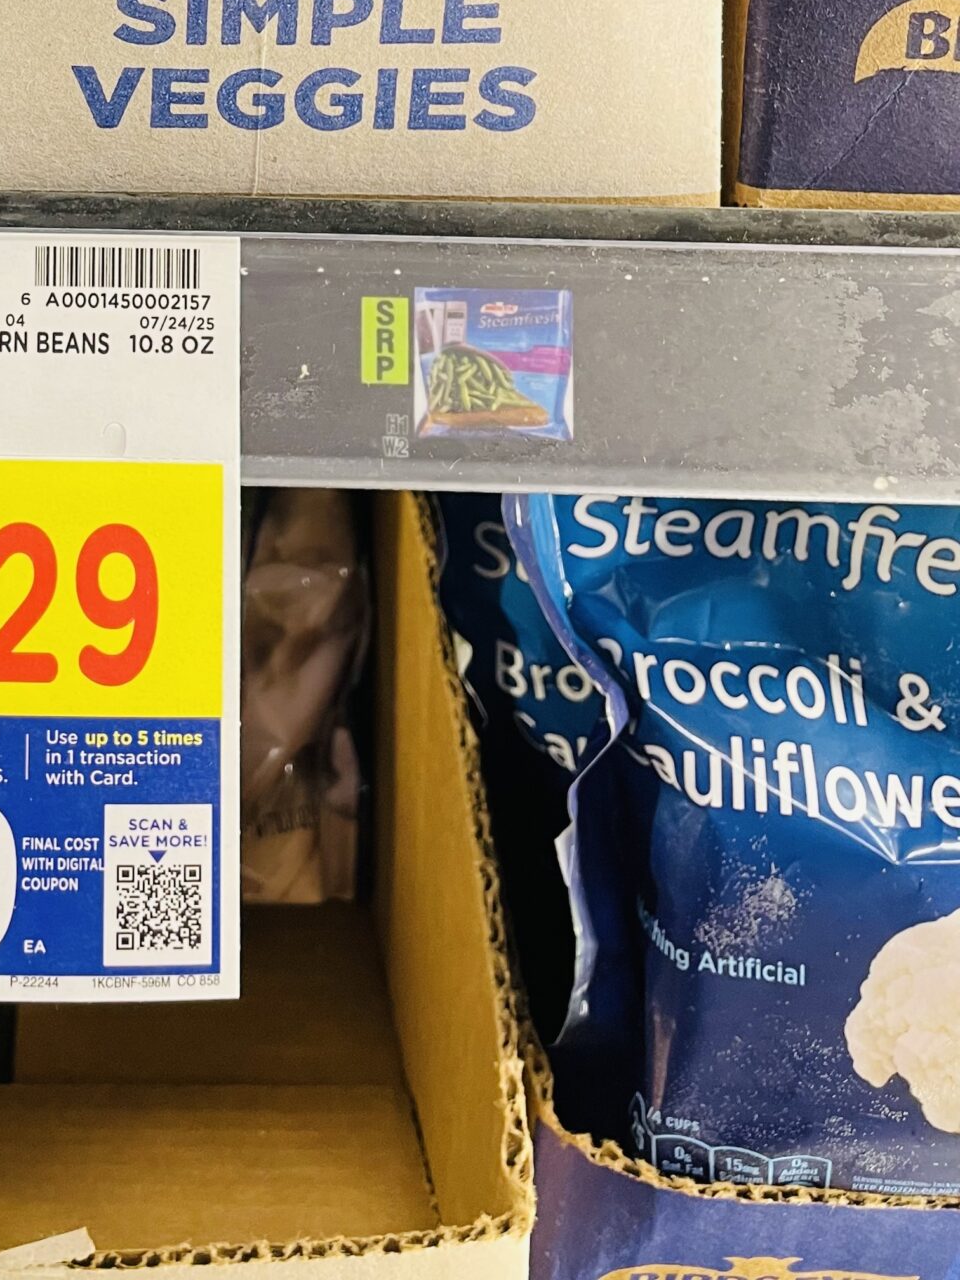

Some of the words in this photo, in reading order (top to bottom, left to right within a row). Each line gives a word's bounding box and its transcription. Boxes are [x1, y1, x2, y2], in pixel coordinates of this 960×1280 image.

[71, 64, 538, 134] VEGGIES
[20, 292, 31, 306] 6
[45, 292, 211, 310] A0001450002157
[5, 313, 25, 326] 04
[139, 316, 215, 331] 07/24/25
[36, 331, 110, 355] BEANS
[129, 334, 174, 354] 10.8
[182, 335, 215, 355] OZ
[895, 672, 946, 732] &
[46, 729, 78, 745] Use
[84, 732, 109, 747] up
[112, 731, 132, 746] to
[136, 731, 149, 746] 5
[153, 730, 203, 746] times
[45, 749, 62, 765] in
[66, 749, 74, 765] 1
[80, 750, 181, 765] transaction
[45, 769, 85, 785] with
[89, 770, 138, 786] Card.
[128, 818, 173, 831] SCAN
[178, 818, 188, 831] &
[21, 837, 61, 851] FINAL
[64, 837, 100, 851] COST
[108, 835, 150, 847] SAVE
[155, 835, 208, 848] MORE!
[21, 857, 54, 871] WITH
[57, 857, 104, 871] DIGITAL
[21, 877, 79, 891] COUPON
[23, 939, 47, 954] EA
[698, 949, 806, 986] Artificial
[9, 975, 59, 988] P-22244
[177, 975, 196, 987] CO
[199, 975, 221, 986] 858
